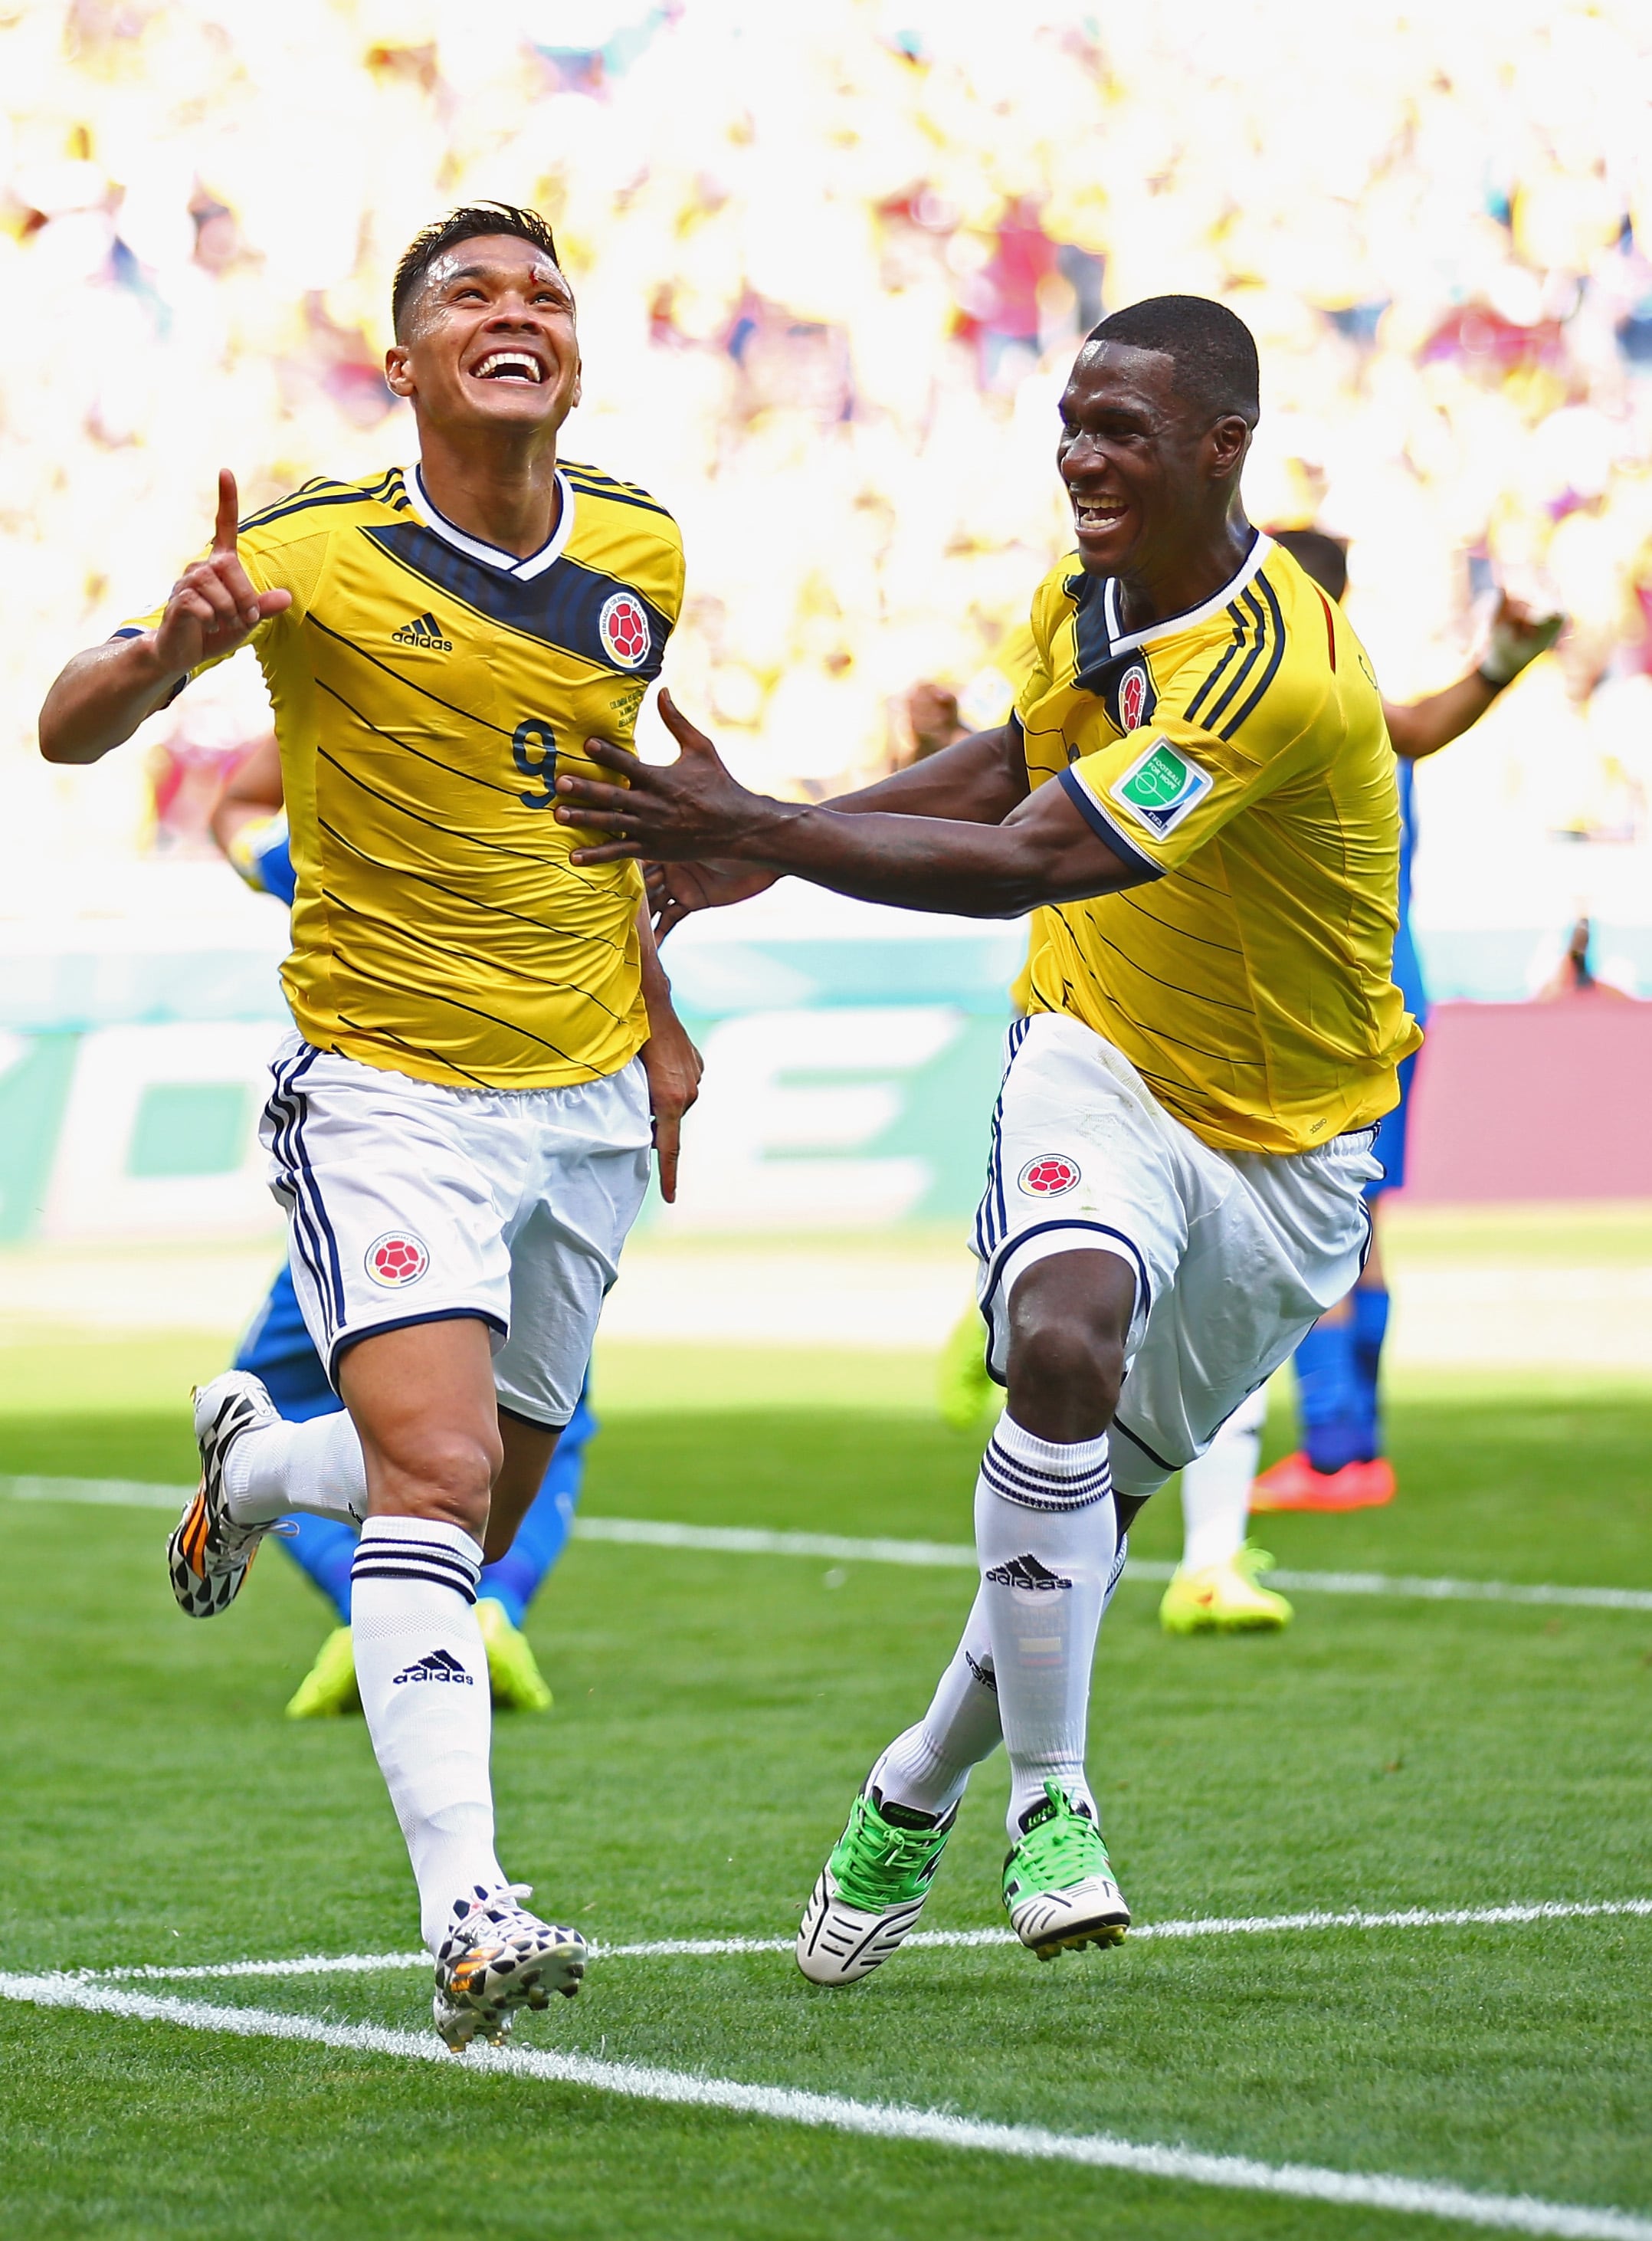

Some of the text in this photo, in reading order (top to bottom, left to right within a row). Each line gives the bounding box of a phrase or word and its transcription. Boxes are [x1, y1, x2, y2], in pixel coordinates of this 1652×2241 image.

[392, 632, 453, 651] adidas
[512, 718, 557, 809] 9
[1152, 756, 1183, 786] FOOTBALL
[1147, 762, 1178, 790] FOR HOPE
[985, 1570, 1073, 1590] adidas
[392, 1668, 474, 1685] adidas
